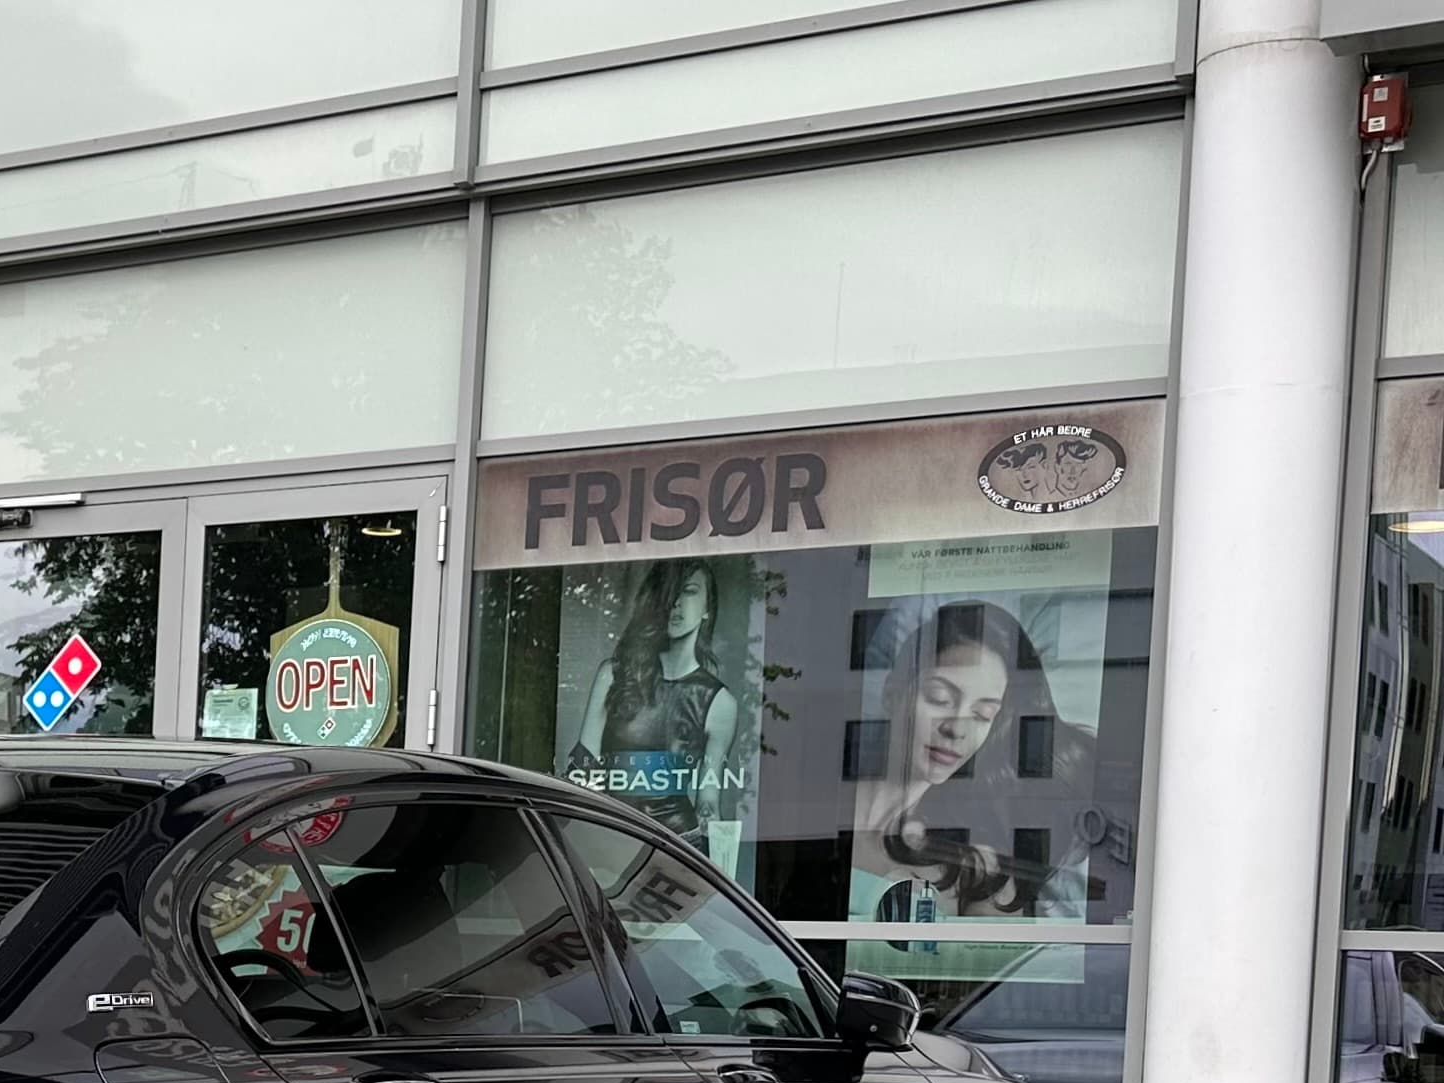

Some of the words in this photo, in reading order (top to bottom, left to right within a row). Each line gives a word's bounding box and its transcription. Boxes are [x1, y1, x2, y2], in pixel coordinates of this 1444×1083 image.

[1013, 432, 1027, 444] ET
[1057, 425, 1092, 438] BEDRE
[524, 453, 827, 550] FRISØR
[979, 475, 1010, 508] GRANDE
[1013, 502, 1043, 513] DAME
[276, 655, 376, 713] OPEN
[568, 767, 746, 792] SEBASTIAN
[88, 993, 153, 1011] eDrive
